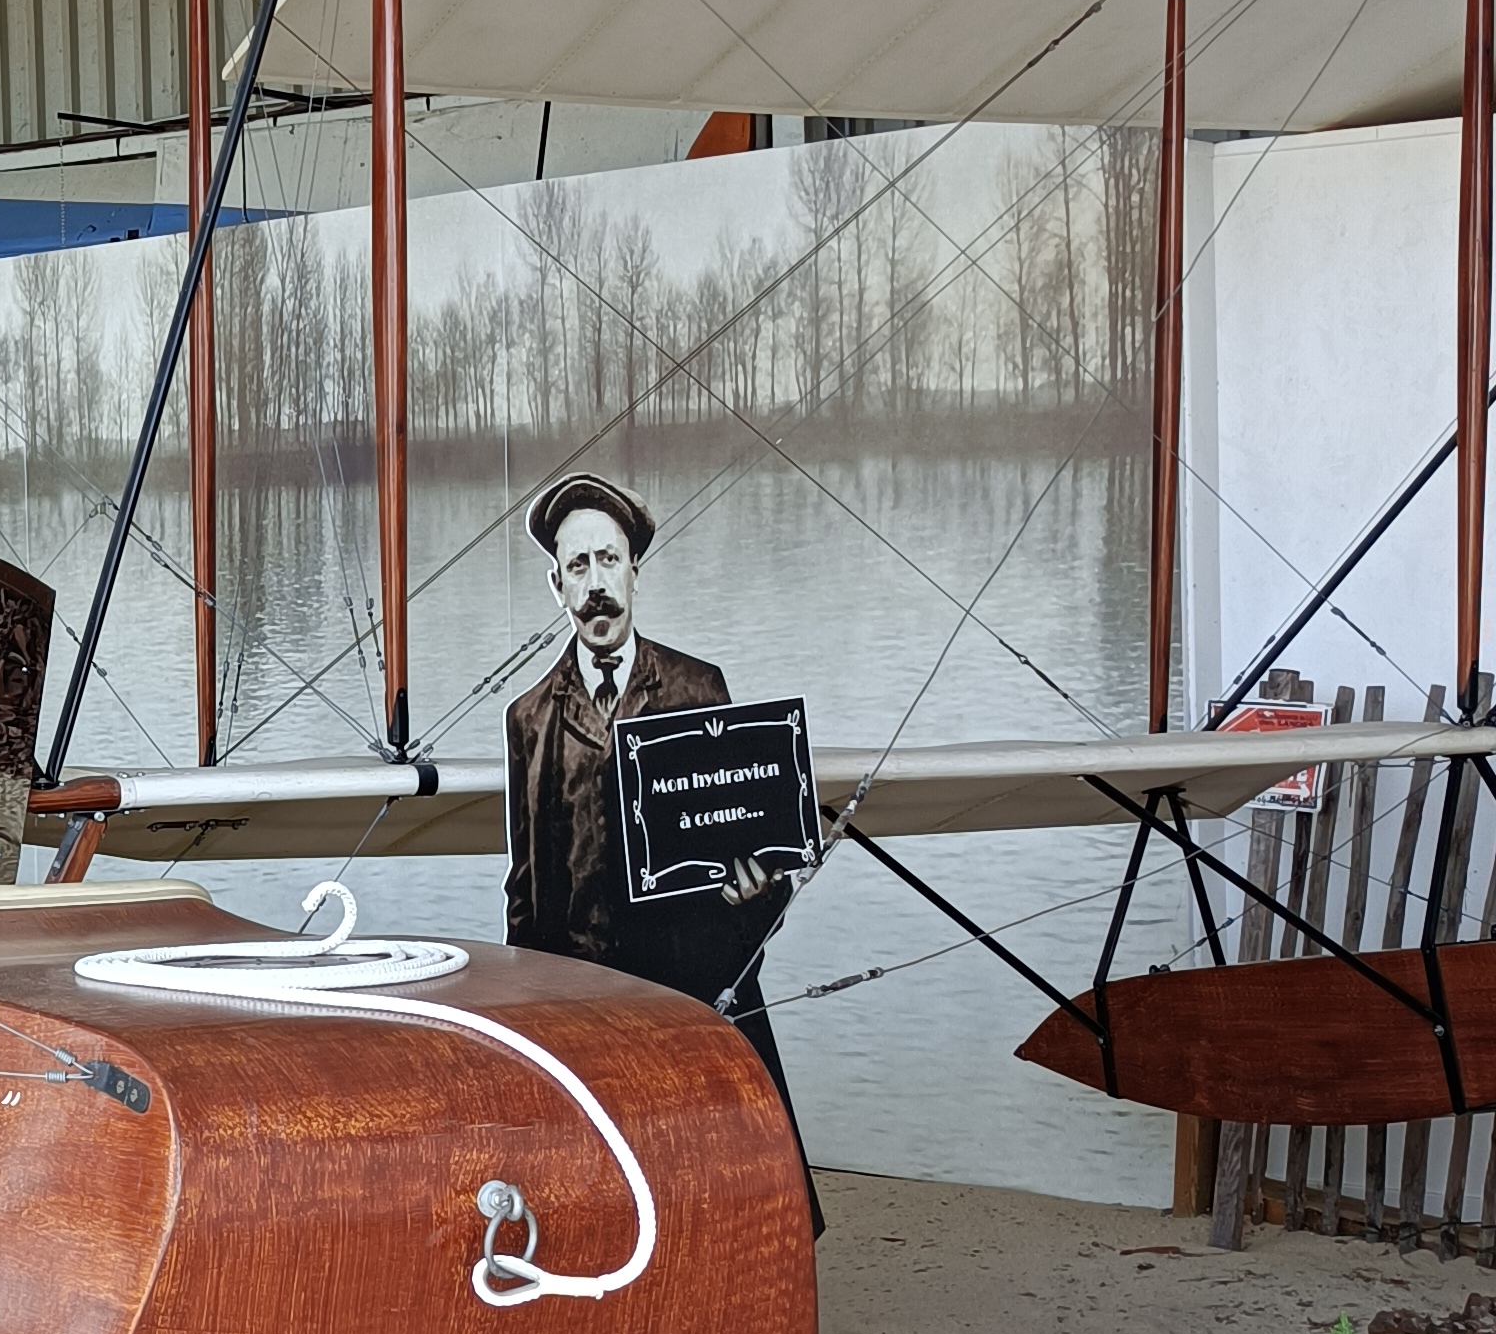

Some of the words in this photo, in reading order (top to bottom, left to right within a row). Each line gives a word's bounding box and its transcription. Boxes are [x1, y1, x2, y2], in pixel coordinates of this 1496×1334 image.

[651, 776, 689, 795] Mon
[692, 763, 780, 790] hydravion
[679, 811, 691, 829] à
[695, 806, 765, 827] coque...
